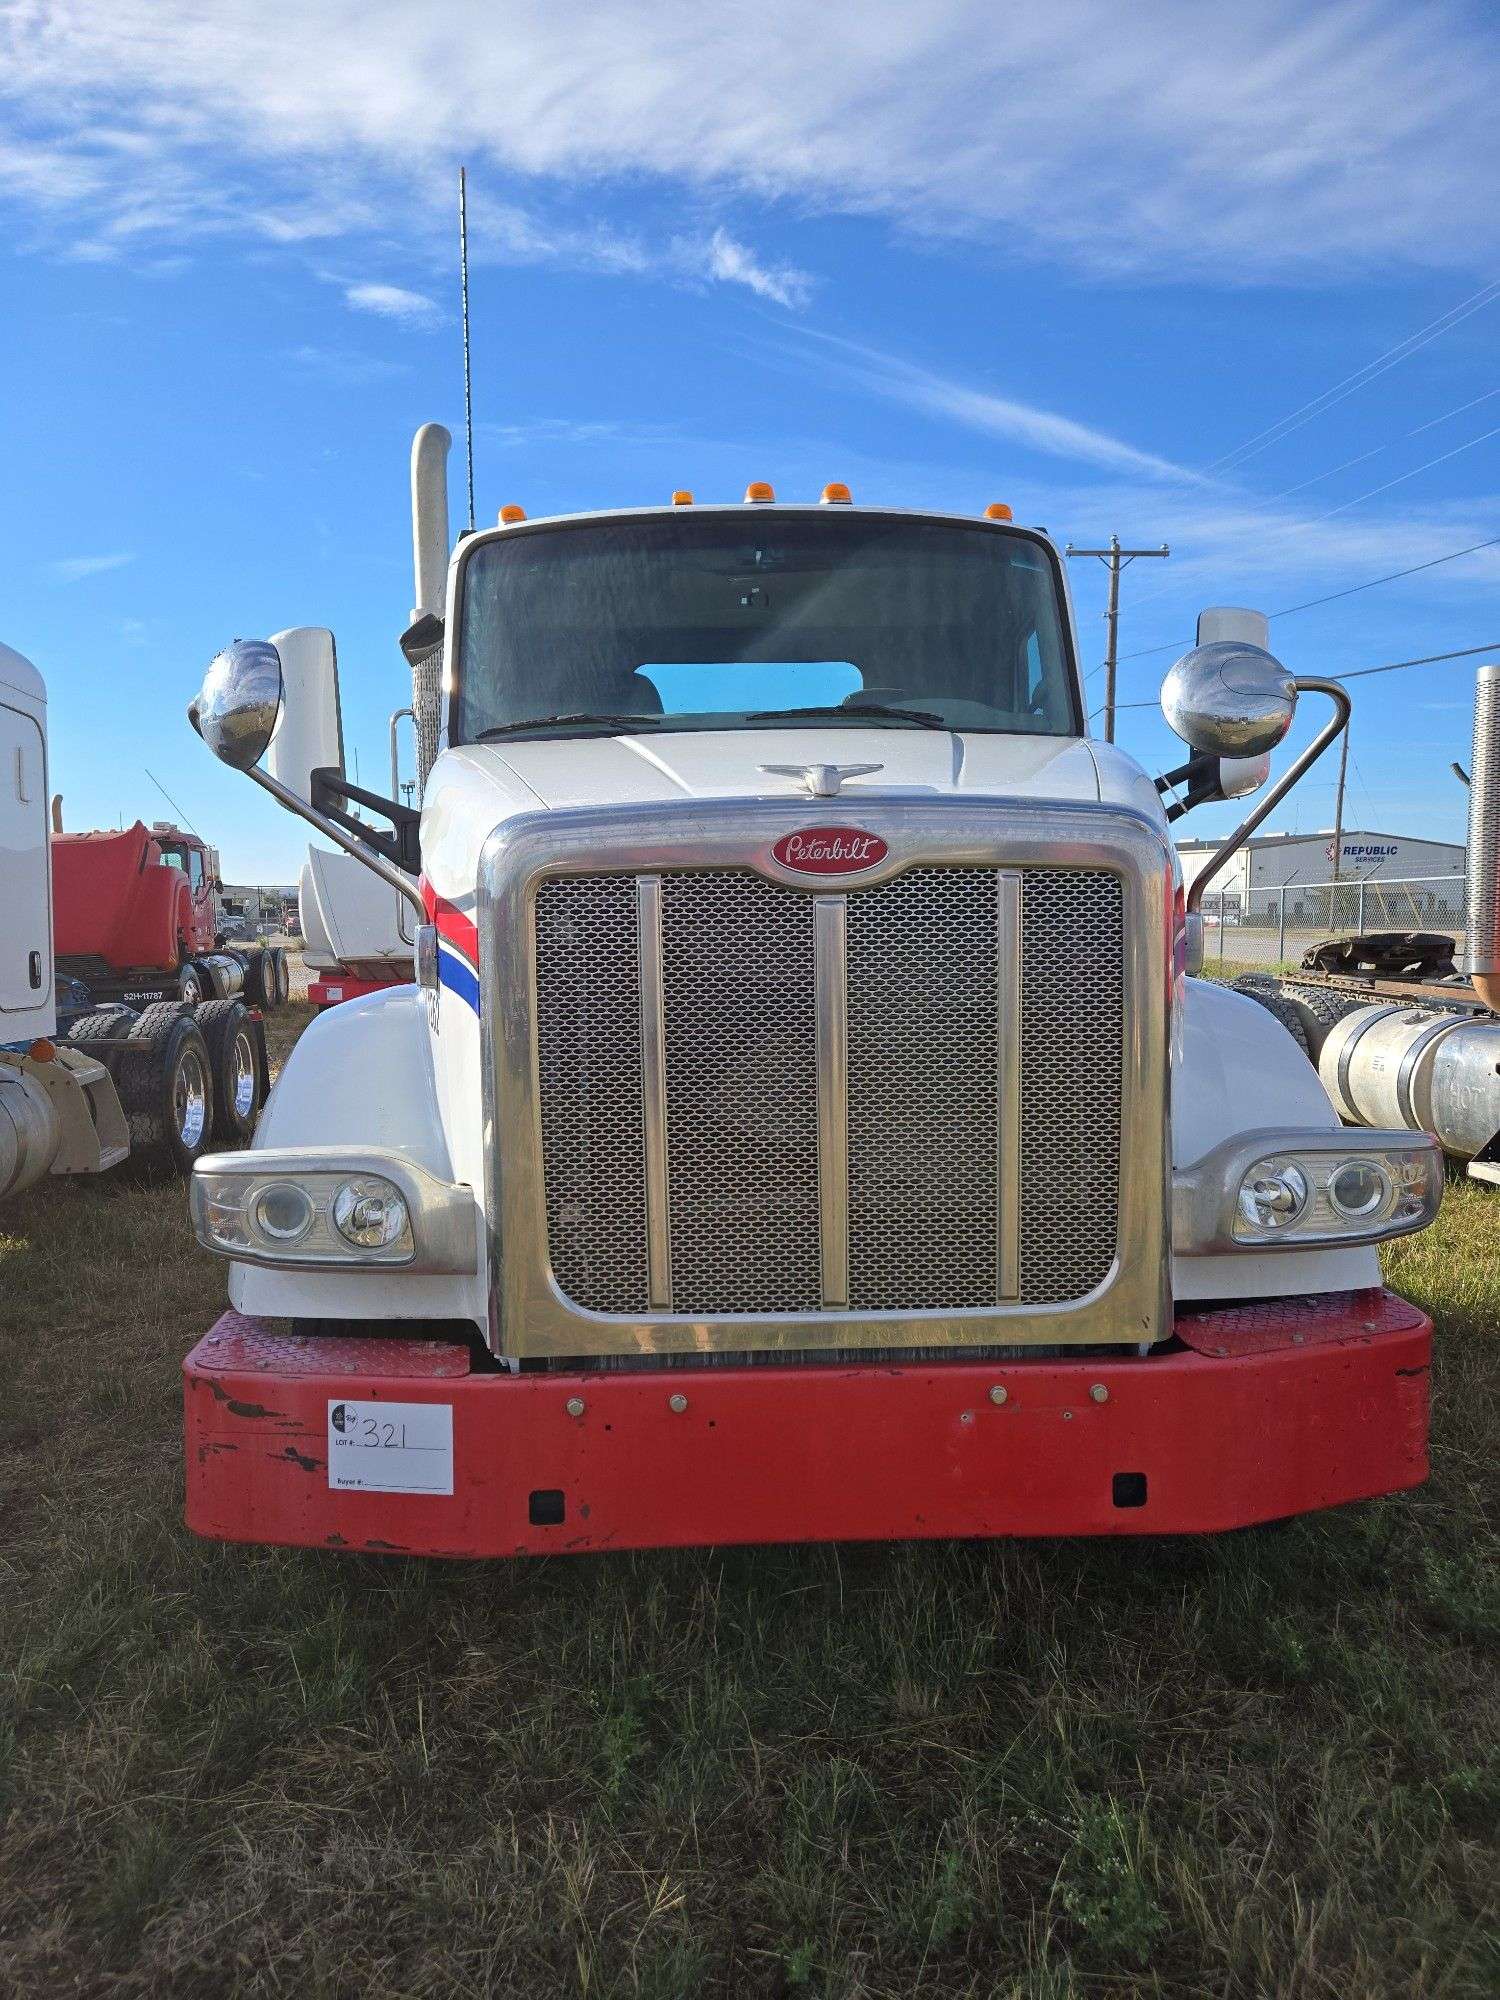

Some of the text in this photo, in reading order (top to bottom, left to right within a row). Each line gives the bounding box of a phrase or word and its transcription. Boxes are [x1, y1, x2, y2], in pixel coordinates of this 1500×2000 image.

[785, 835, 879, 862] Peterbilt
[1343, 846, 1399, 856] REPUBLIC
[363, 1418, 405, 1449] 321
